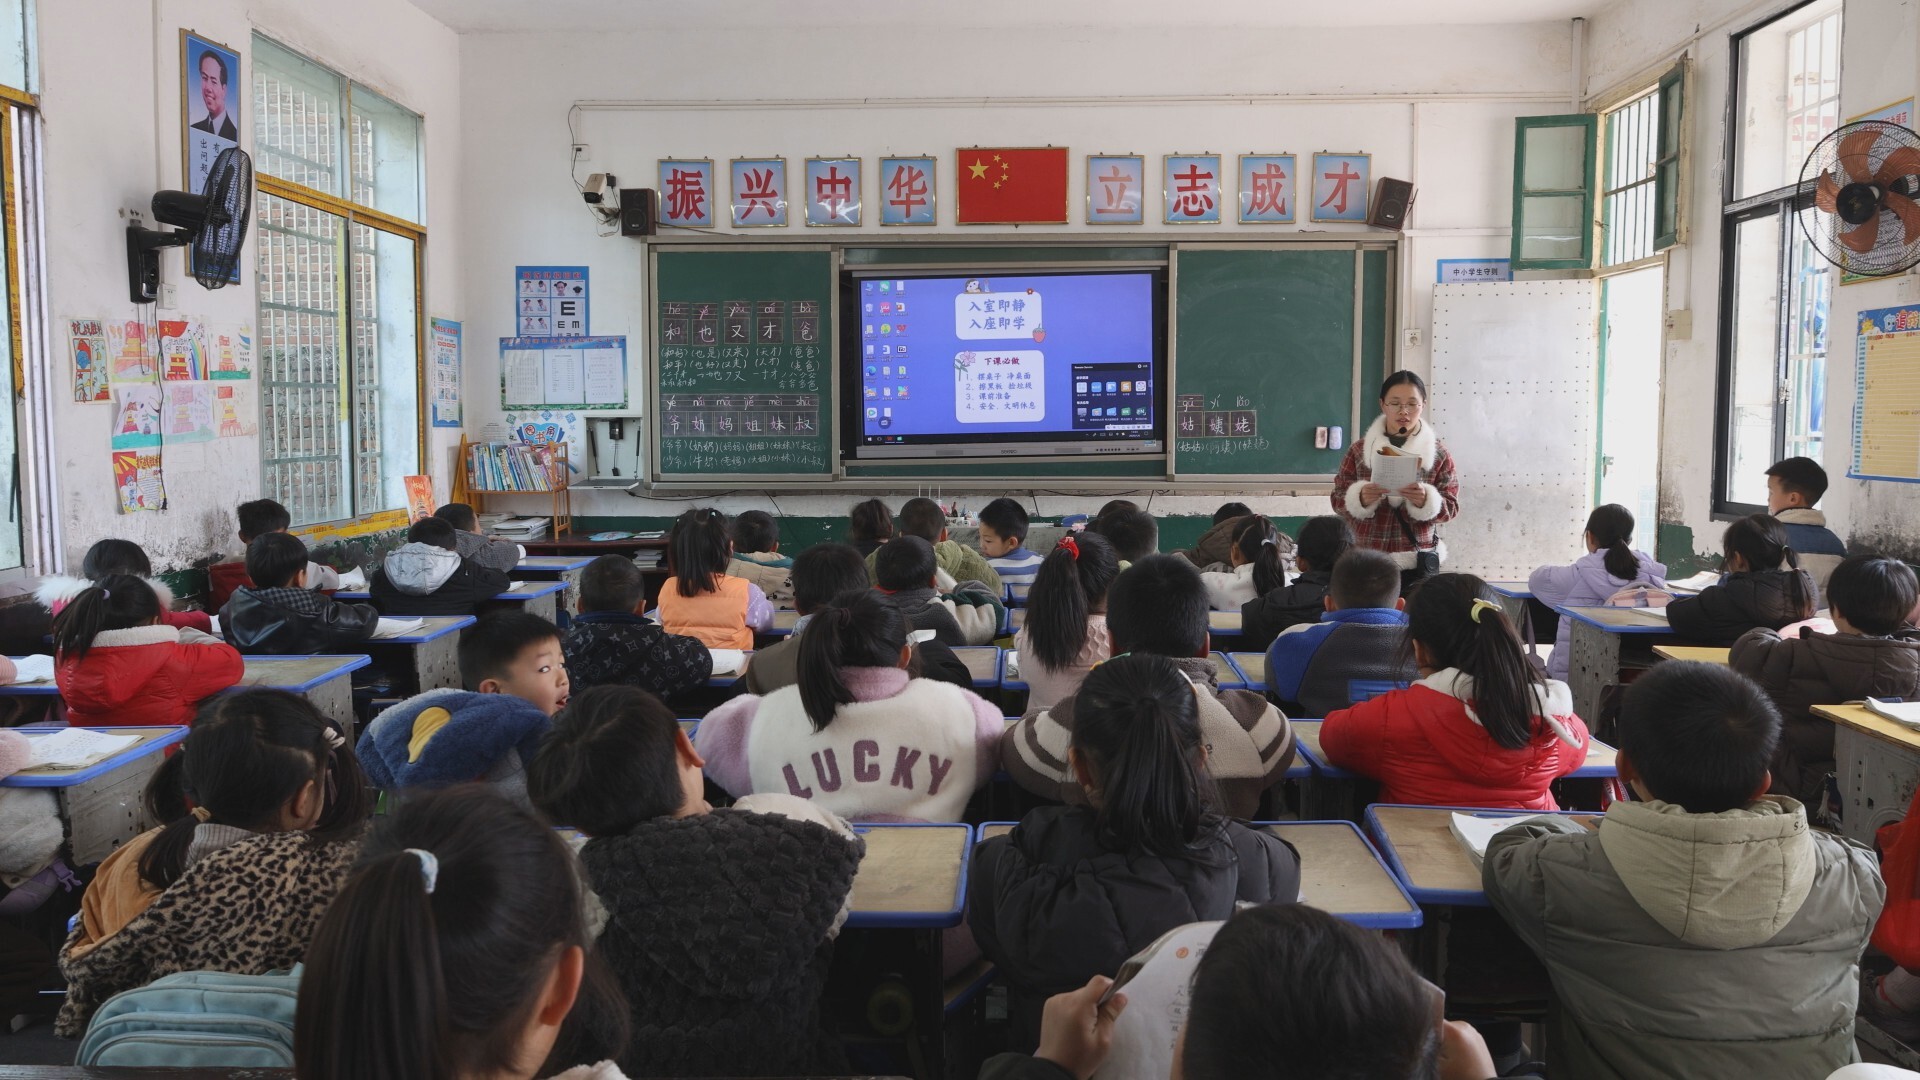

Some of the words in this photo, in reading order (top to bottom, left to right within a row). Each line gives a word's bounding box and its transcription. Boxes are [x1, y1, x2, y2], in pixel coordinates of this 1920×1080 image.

[666, 165, 927, 220] 振兴中华
[1096, 161, 1360, 217] 立志成才
[1453, 268, 1498, 276] 中小学生守则
[968, 299, 1025, 313] 入室即静
[969, 316, 1025, 330] 入座即学
[1884, 309, 1920, 331] 你追我
[665, 323, 681, 340] 和
[699, 325, 715, 342] 也
[731, 324, 745, 338] 又
[763, 321, 777, 339] 才
[800, 321, 813, 341] 爸
[984, 357, 1020, 366] 下课必做
[668, 414, 680, 434] 爷
[691, 416, 705, 432] 奶
[719, 415, 733, 431] 妈
[745, 416, 762, 432] 姐
[770, 415, 786, 431] 妹
[794, 415, 814, 431] 叔
[1182, 416, 1194, 431] 姑
[1209, 416, 1225, 435] 姨
[1235, 416, 1251, 433] 姥
[782, 739, 952, 800] LUCKY
